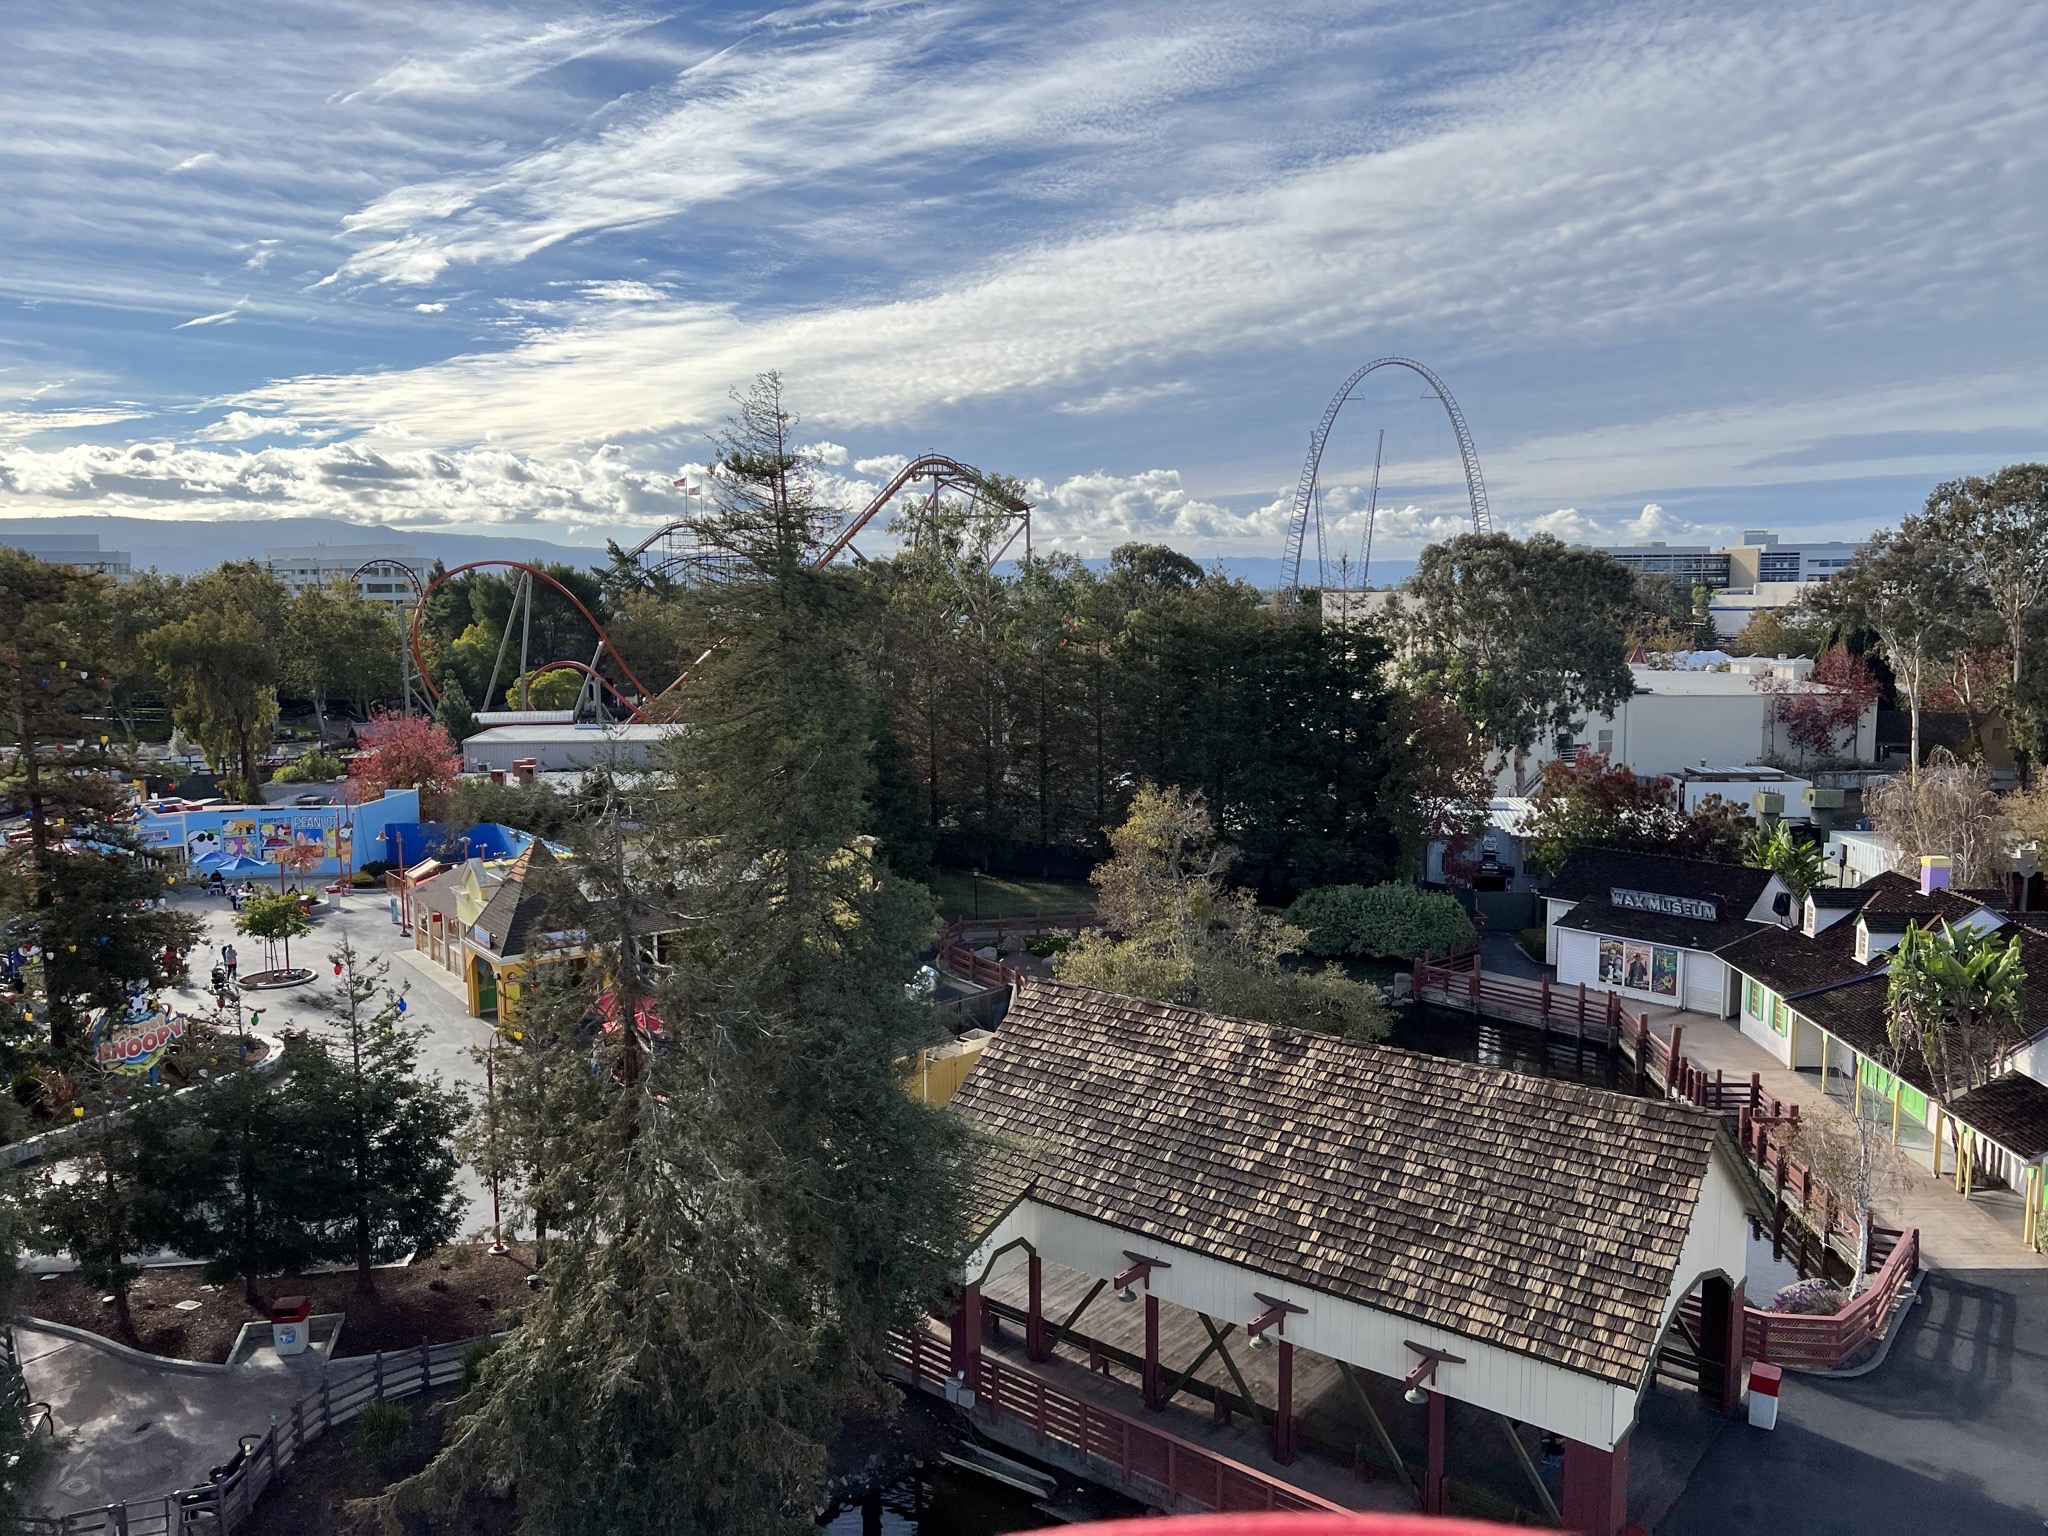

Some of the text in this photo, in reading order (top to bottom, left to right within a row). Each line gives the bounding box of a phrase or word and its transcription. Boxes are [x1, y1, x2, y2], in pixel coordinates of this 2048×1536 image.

[294, 816, 339, 829] PEANUTS
[1611, 892, 1717, 919] WAX MUSEUM
